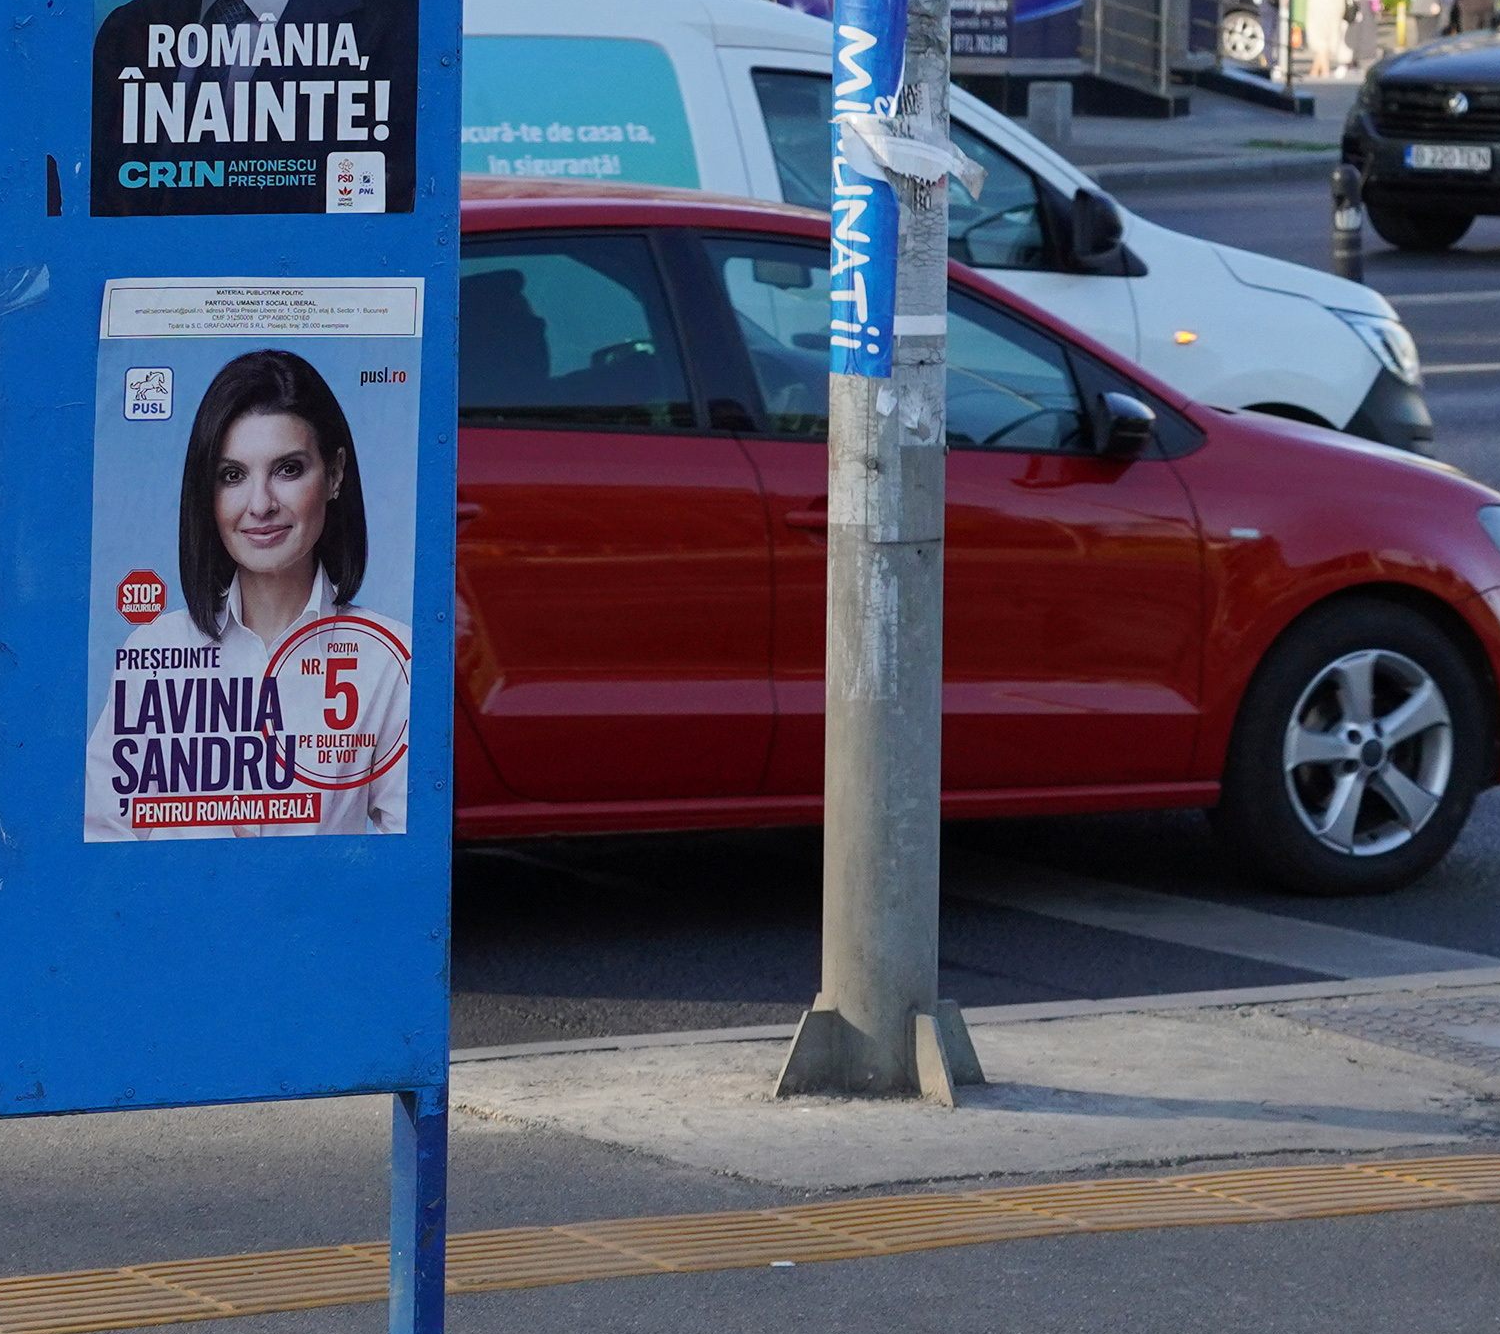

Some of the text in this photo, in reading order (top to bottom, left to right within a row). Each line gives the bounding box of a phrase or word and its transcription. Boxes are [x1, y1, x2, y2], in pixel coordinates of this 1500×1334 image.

[147, 13, 370, 71] ROMÂNIA,
[117, 67, 391, 144] ÎNAINTE!
[546, 121, 574, 143] de
[577, 125, 625, 143] casa
[118, 159, 317, 189] CRIN ANTONESCU
[228, 174, 317, 189] PREȘEDINTE
[338, 174, 354, 183] PSD
[360, 367, 407, 386] pusl.ro
[132, 402, 166, 414] PUSL
[122, 582, 162, 604] STOP
[121, 603, 161, 613] ABUZURILOR
[327, 642, 359, 656] POZIȚIA
[115, 646, 221, 678] PREȘEDINTE
[301, 658, 359, 730] NR. 5
[113, 676, 284, 736] LAVINIA
[299, 733, 377, 749] PE BULETINUL
[318, 749, 358, 764] DE VOT
[135, 794, 315, 823] PENTRU ROMÂNIA REALĂ
